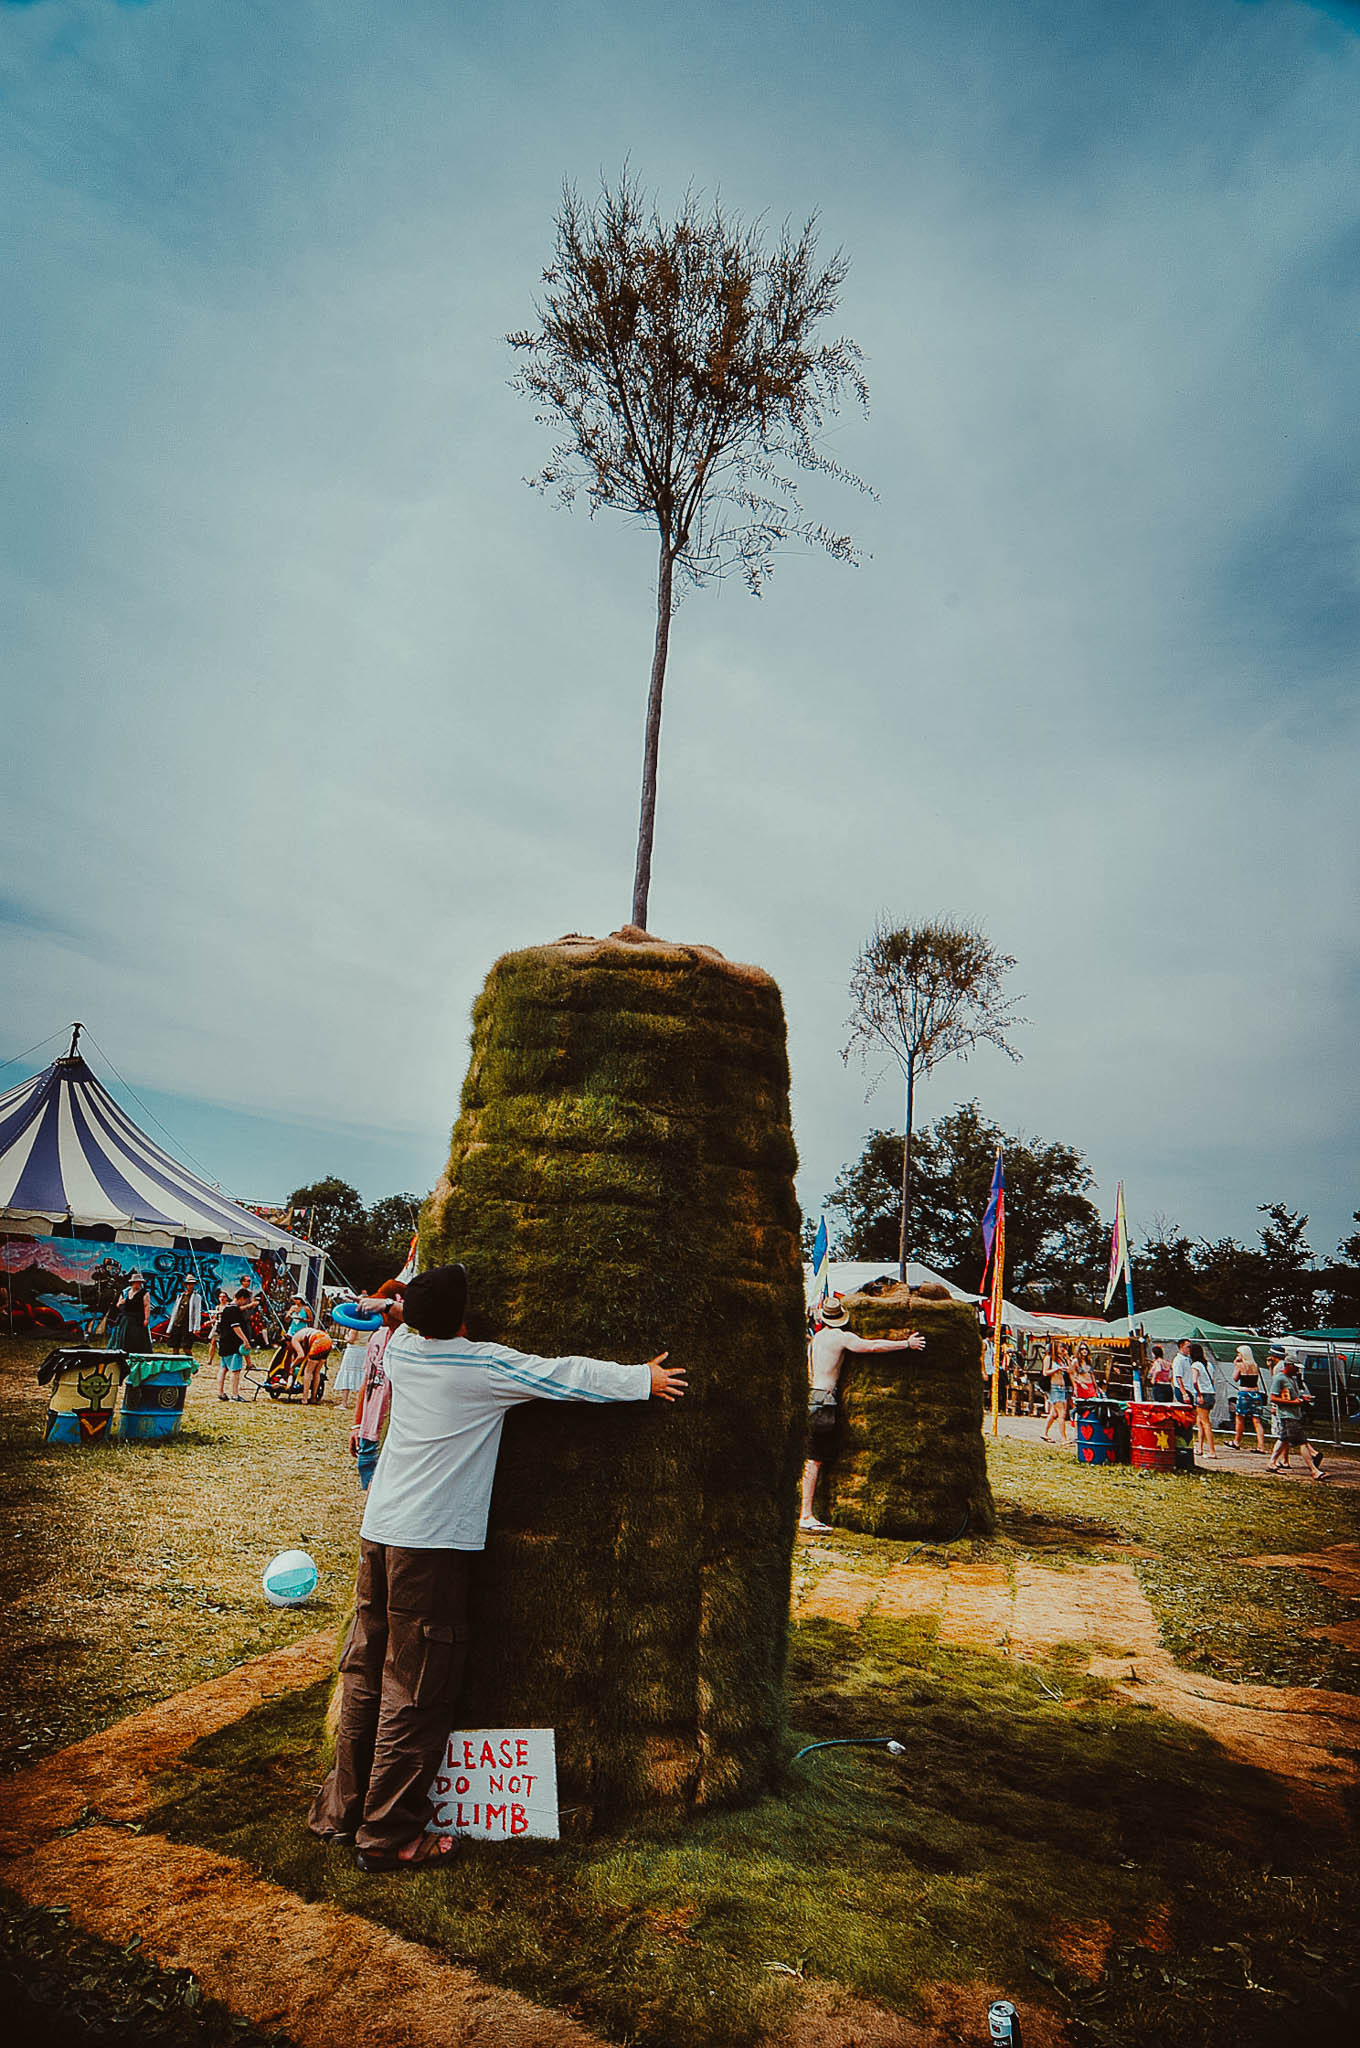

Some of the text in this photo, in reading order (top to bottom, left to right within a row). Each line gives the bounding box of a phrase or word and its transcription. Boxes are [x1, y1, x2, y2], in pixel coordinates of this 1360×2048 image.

[447, 1739, 528, 1769] LEASE
[435, 1774, 538, 1797] DO NOT
[431, 1802, 529, 1834] CLIMB
